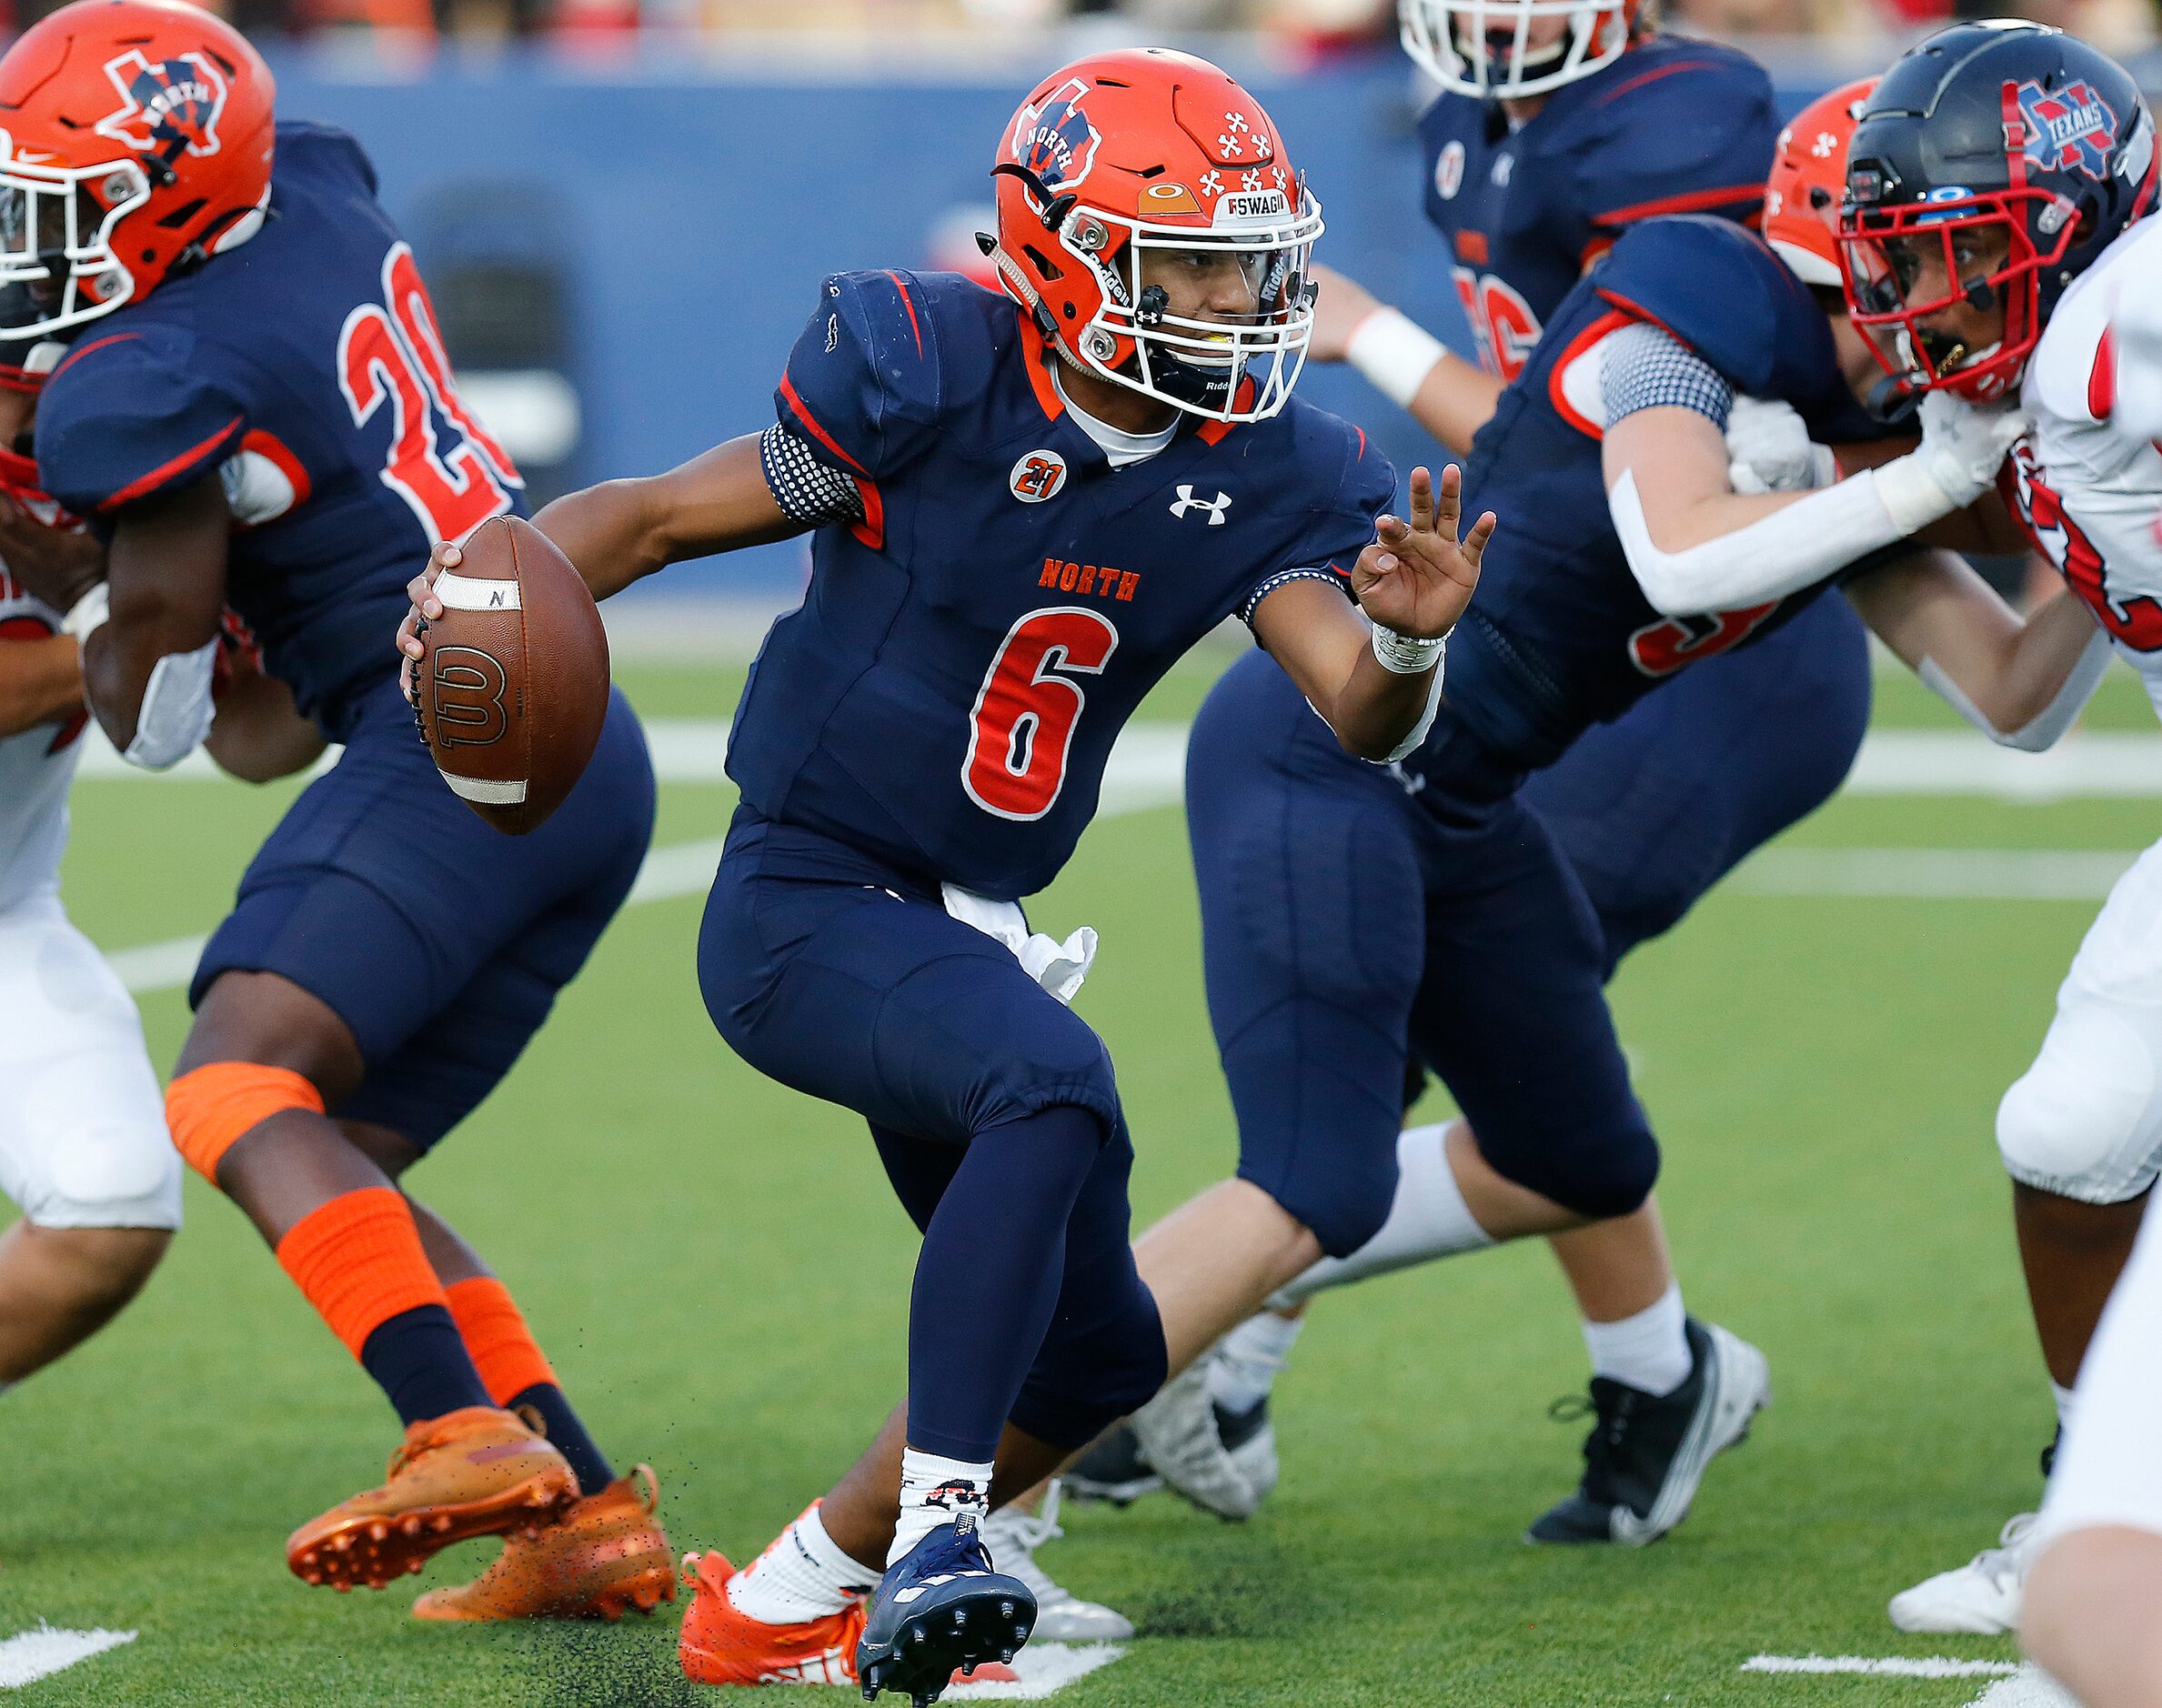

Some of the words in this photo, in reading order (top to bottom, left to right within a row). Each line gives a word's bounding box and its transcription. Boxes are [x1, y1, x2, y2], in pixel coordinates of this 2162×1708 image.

[2046, 102, 2103, 144] TEXANS
[1026, 126, 1073, 171] NORTH
[1206, 382, 1231, 390] Ridd
[1014, 457, 1064, 498] 21
[489, 588, 506, 608] N
[1039, 558, 1141, 602] NORTH
[960, 606, 1119, 822] 6
